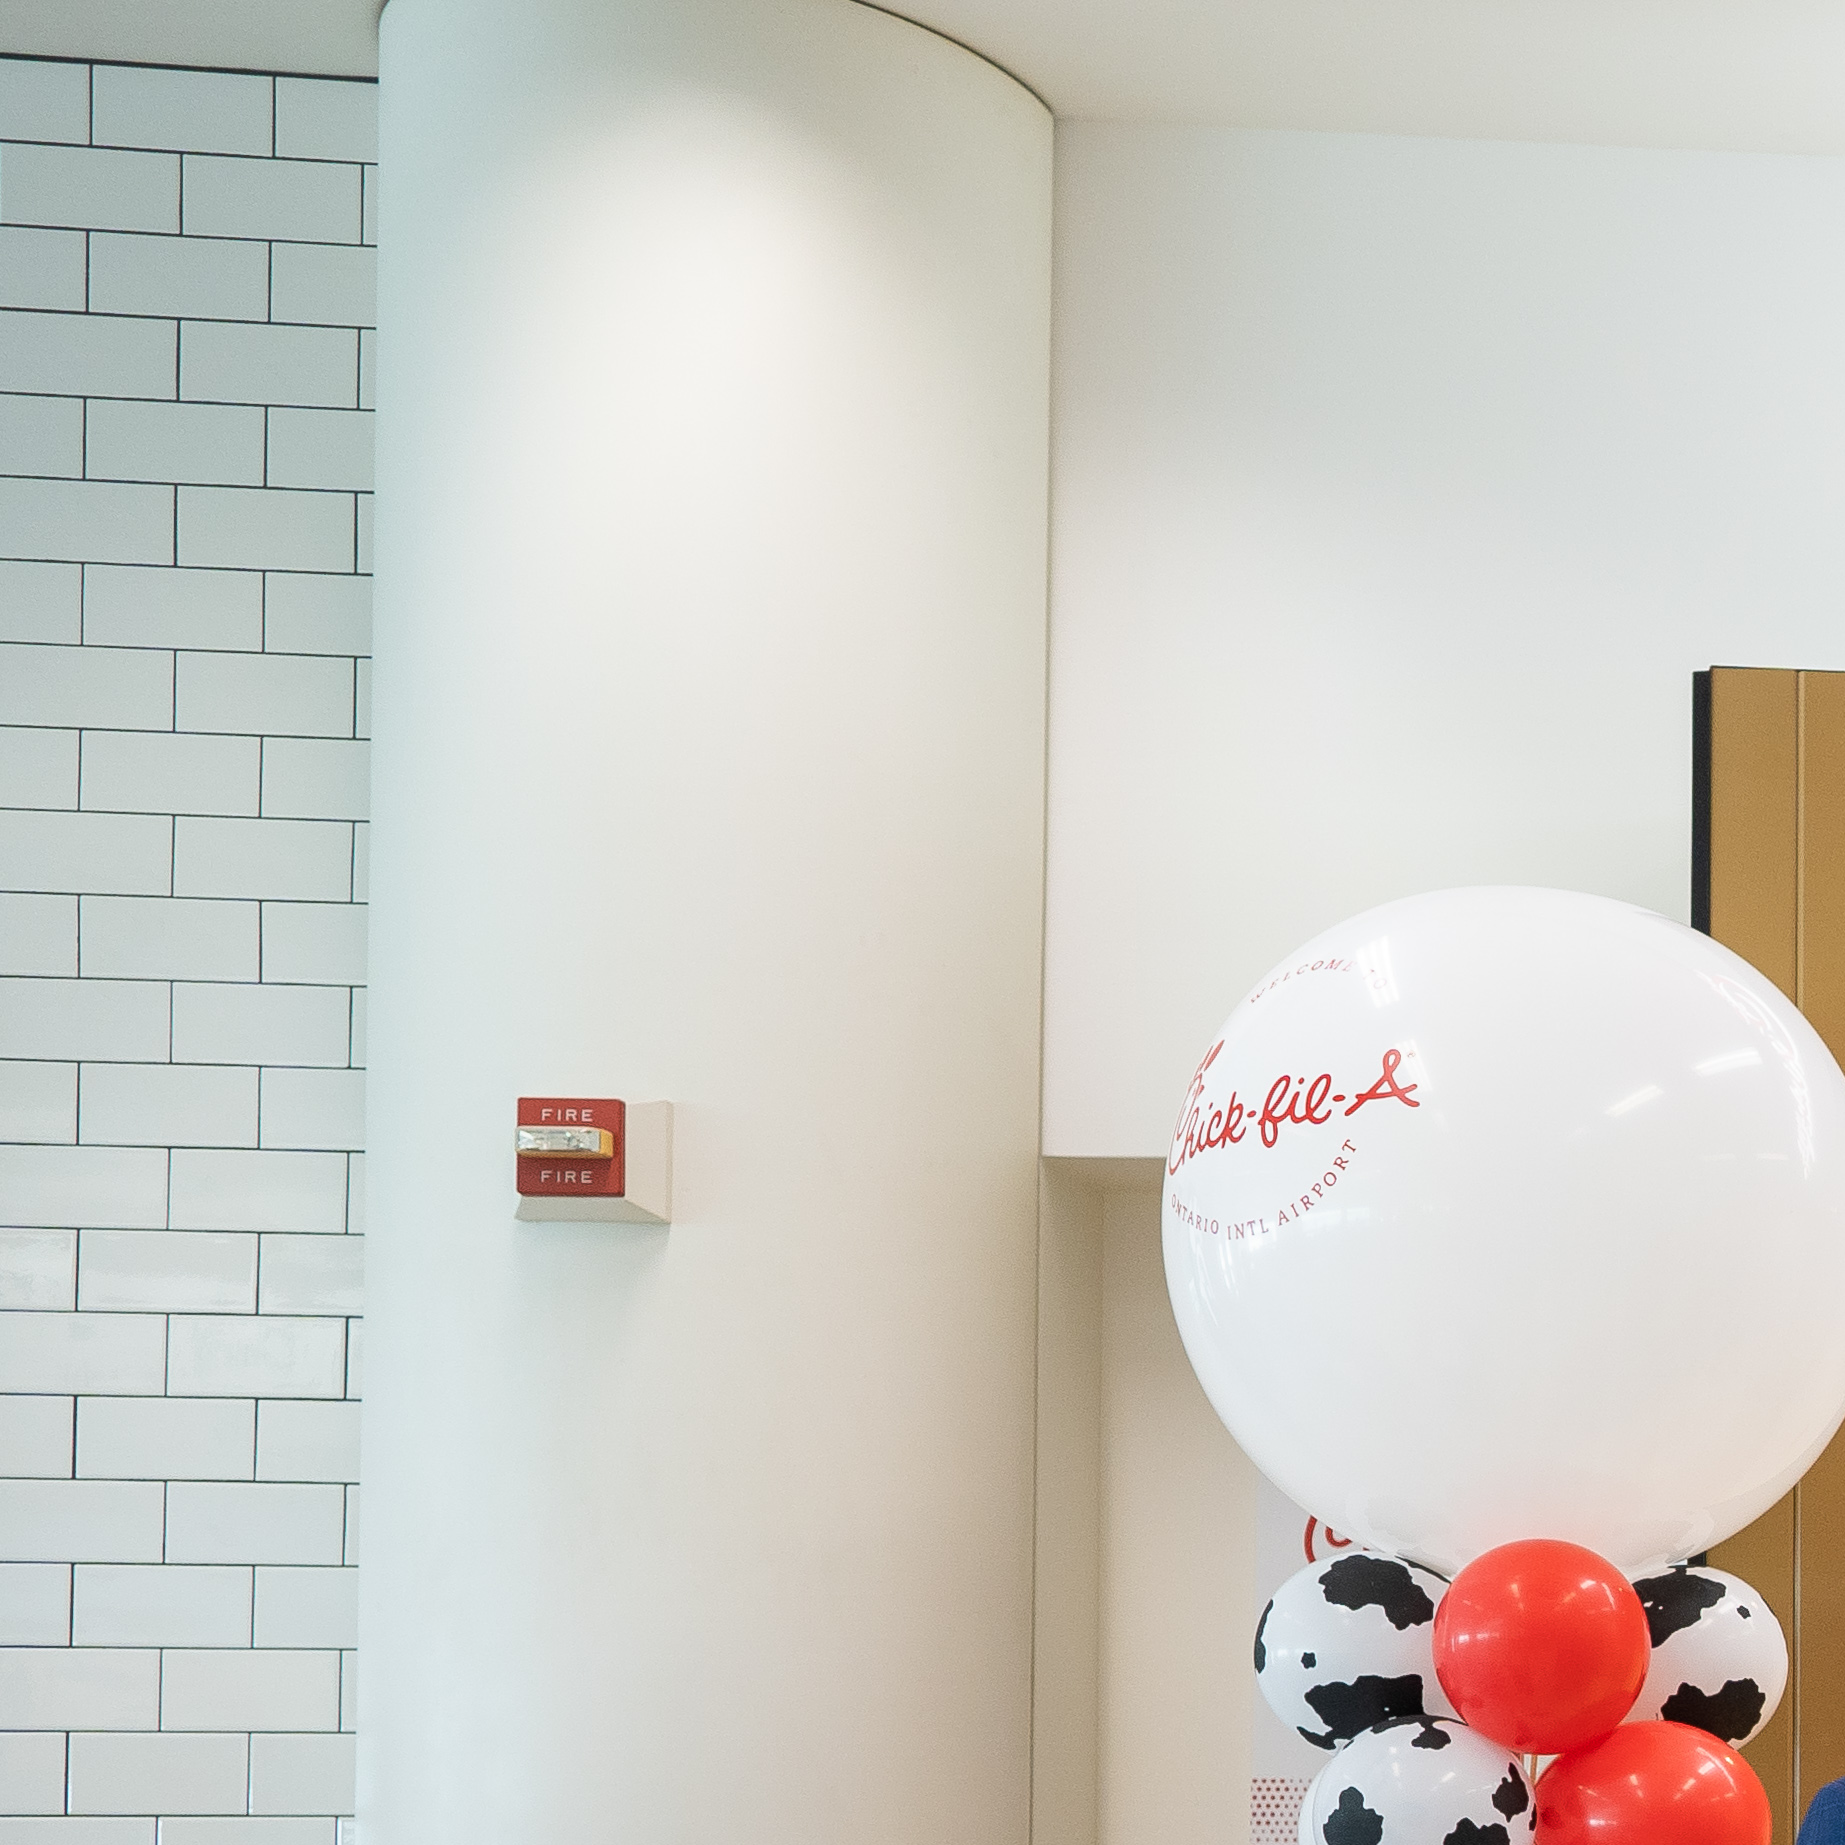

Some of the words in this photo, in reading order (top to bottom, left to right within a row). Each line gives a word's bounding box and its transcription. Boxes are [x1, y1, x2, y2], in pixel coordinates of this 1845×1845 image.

[541, 1108, 594, 1123] FIRE
[540, 1170, 593, 1184] FIRE
[1171, 1193, 1219, 1235] ONTARIO
[1227, 1218, 1269, 1241] INTL
[1277, 1138, 1357, 1227] AIRPORT
